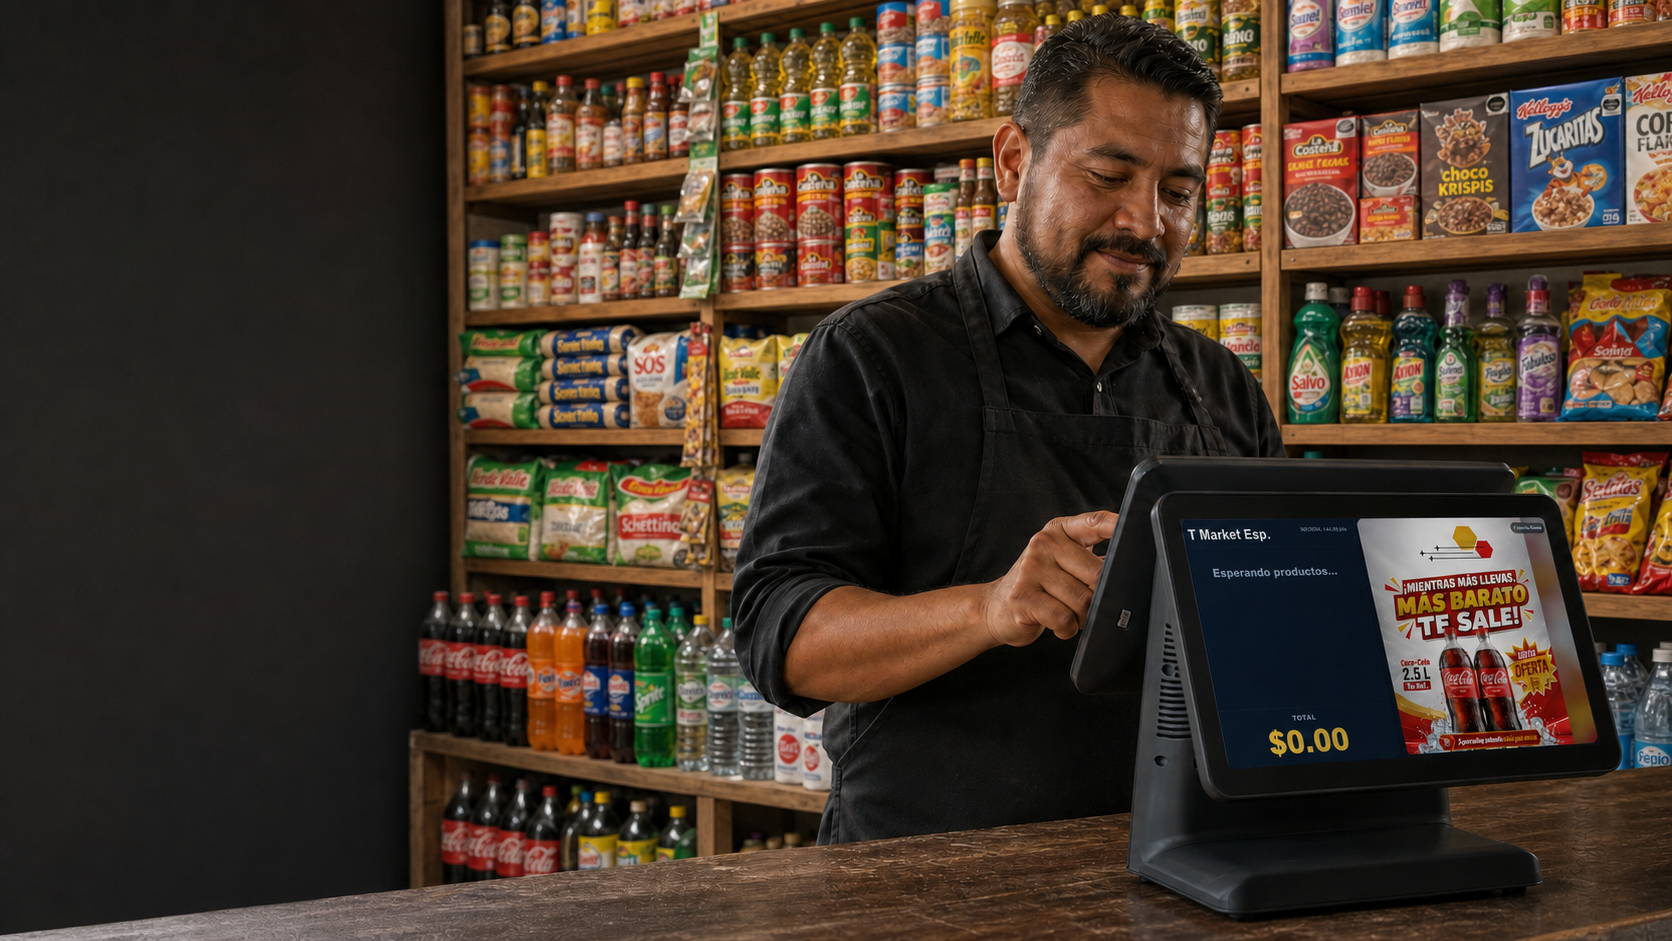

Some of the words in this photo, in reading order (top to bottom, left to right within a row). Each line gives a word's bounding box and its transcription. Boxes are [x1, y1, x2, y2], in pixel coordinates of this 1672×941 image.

[1517, 98, 1573, 119] Kellogg's
[1525, 106, 1604, 169] ZUCARITAS
[1442, 167, 1488, 182] choco
[1438, 179, 1494, 197] KRISPIS
[634, 355, 666, 375] SOS
[1292, 375, 1325, 390] Salvo
[1187, 529, 1196, 541] T
[1199, 528, 1242, 541] Market
[1244, 529, 1271, 542] Esp.
[1212, 567, 1271, 579] Esperando
[1274, 567, 1338, 579] productos...
[1397, 590, 1446, 617] MÁS
[1450, 584, 1526, 611] BARATO
[1457, 606, 1520, 632] SALE!
[1402, 667, 1421, 680] 2.5
[1423, 667, 1431, 680] L
[1515, 659, 1550, 678] OFERTA
[1268, 727, 1349, 758] $0.00
